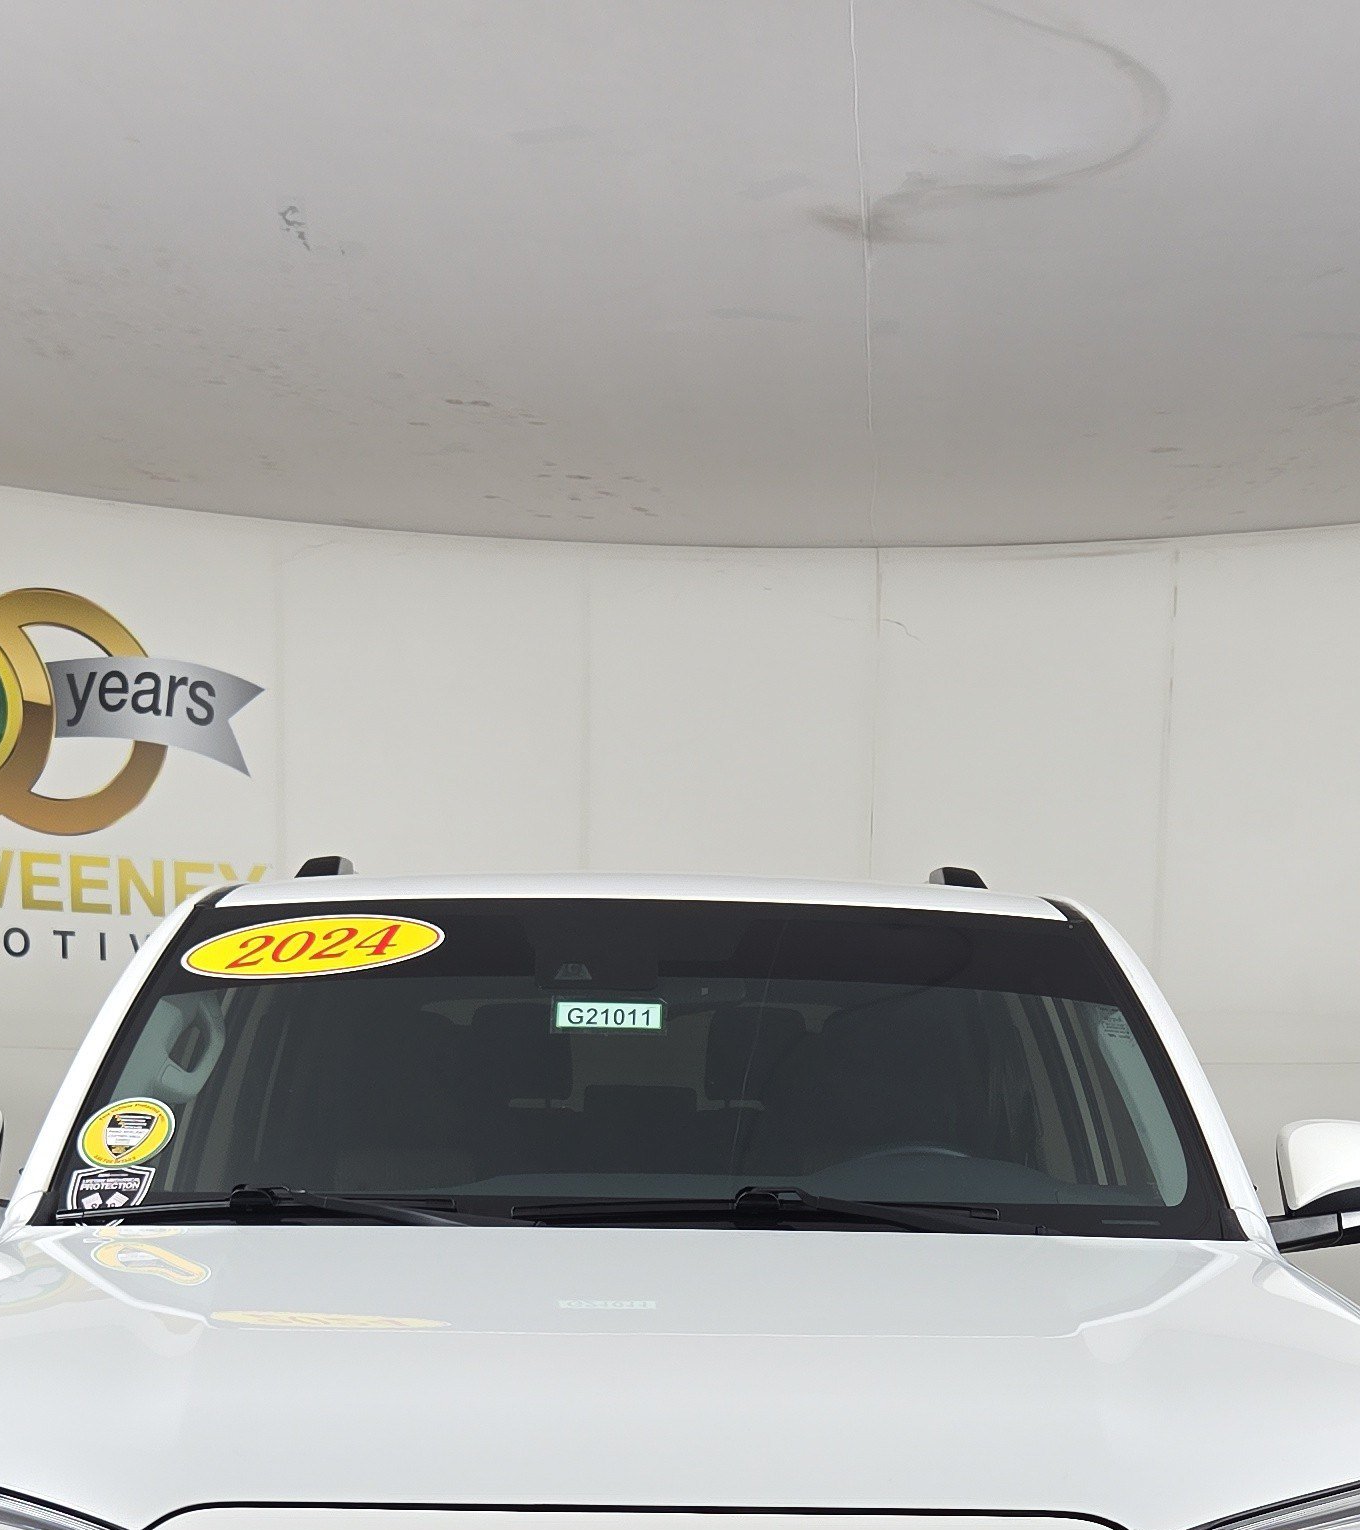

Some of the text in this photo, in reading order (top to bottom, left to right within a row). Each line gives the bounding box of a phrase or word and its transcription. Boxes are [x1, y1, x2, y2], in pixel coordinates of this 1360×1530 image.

[65, 668, 216, 727] years
[225, 925, 399, 969] 2024
[567, 1007, 651, 1027] G21011
[80, 1182, 140, 1191] PROTECTION
